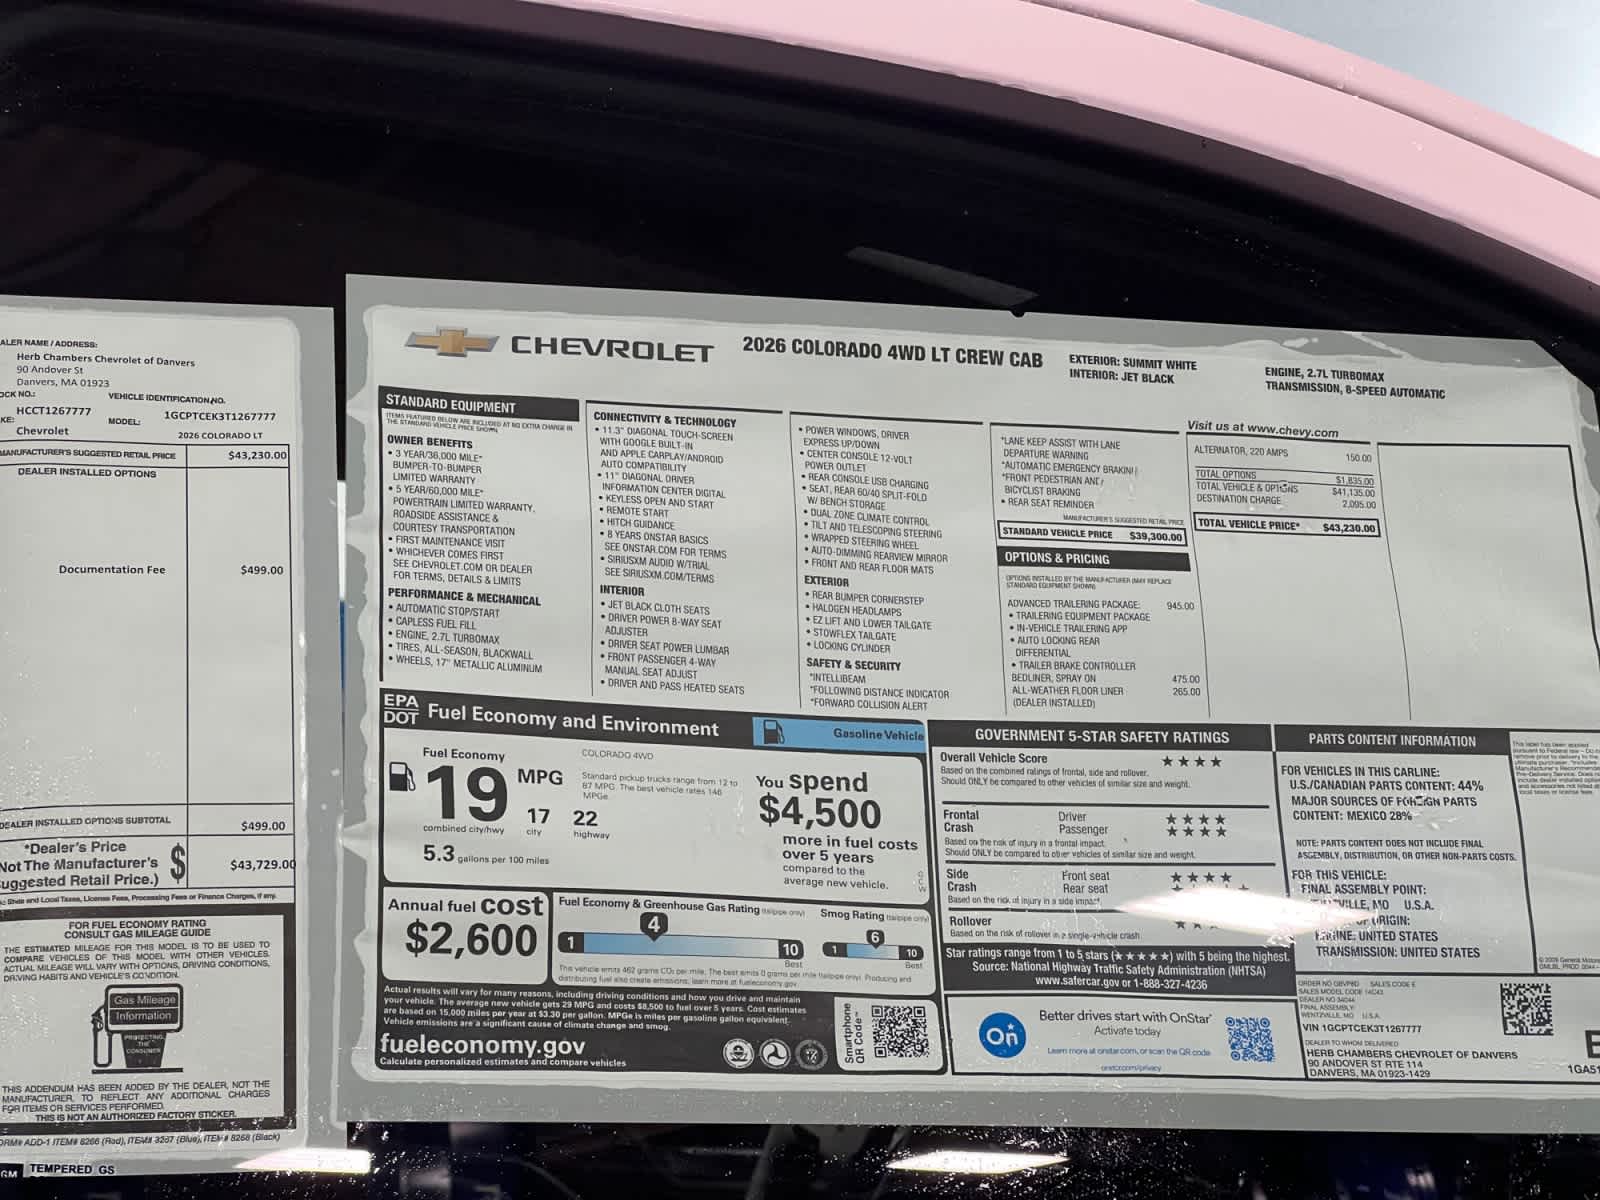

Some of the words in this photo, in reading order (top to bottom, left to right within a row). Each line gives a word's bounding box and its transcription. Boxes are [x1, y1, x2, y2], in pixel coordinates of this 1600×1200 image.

[512, 336, 715, 363] CHEVROLET
[743, 336, 786, 353] 2026
[17, 352, 40, 361] Herb
[43, 353, 93, 362] Chambers
[94, 355, 141, 364] Chevrolet
[144, 356, 154, 365] of
[156, 357, 195, 367] Danvers
[792, 338, 882, 359] COLORADO
[887, 345, 926, 361] 4WD
[931, 346, 951, 363] LT
[956, 348, 1004, 366] CREW
[1009, 351, 1043, 368] CAB
[1069, 354, 1120, 366] EXTERIOR:
[1123, 357, 1163, 369] SUMMIT
[1165, 360, 1197, 371] WHITE
[16, 365, 29, 374] 90
[30, 365, 72, 374] Andover
[74, 366, 83, 375] St
[1069, 368, 1118, 381] INTERIOR:
[1121, 372, 1139, 382] JET
[1141, 373, 1175, 384] BLACK
[1265, 367, 1304, 379] ENGINE,
[1307, 368, 1329, 379] 2.7L
[1330, 369, 1384, 382] TURBOMAX
[16, 378, 58, 387] Danvers,
[61, 378, 78, 386] MA
[80, 379, 110, 388] 01923
[1265, 381, 1343, 395] TRANSMISSION,
[1345, 385, 1387, 396] 8-SPEED
[1390, 387, 1446, 399] AUTOMATIC
[385, 393, 448, 411] STANDARD
[451, 400, 516, 414] EQUIPMENT
[108, 417, 141, 426] MODEL:
[594, 411, 661, 424] CONNECTIVITY
[664, 415, 672, 424] &
[674, 416, 737, 428] TECHNOLOGY
[16, 426, 69, 436] Chevrolet
[178, 431, 200, 439] 2026
[1188, 420, 1212, 431] Visit
[1216, 423, 1229, 431] us
[1232, 423, 1244, 432] at
[1246, 425, 1339, 440] www.chevy.com
[387, 434, 423, 445] OWNER
[426, 437, 473, 449] BENEFITS
[228, 450, 287, 461] $43,230.00
[1346, 453, 1372, 463] 150.00
[18, 467, 57, 476] DEALER
[59, 468, 112, 477] INSTALLED
[114, 469, 157, 478] OPTIONS
[606, 505, 641, 516] REMOTE
[642, 508, 669, 518] START
[607, 517, 632, 528] HITCH
[633, 519, 676, 531] GUIDANCE
[1196, 518, 1227, 530] TOTAL
[1228, 520, 1268, 532] VEHICLE
[1323, 523, 1376, 533] $43,230.00
[1001, 527, 1049, 539] STANDARD
[1050, 529, 1086, 538] VEHICLE
[1088, 530, 1113, 539] PRICE
[1129, 531, 1183, 542] $39,300.00
[1005, 551, 1050, 563] OPTIONS
[1055, 553, 1063, 563] &
[1066, 553, 1110, 565] PRICING
[59, 565, 144, 574] Documentation
[147, 565, 166, 574] Fee
[241, 565, 284, 575] $499.00
[804, 575, 849, 587] EXTERIOR
[388, 587, 464, 601] PERFORMANCE
[466, 592, 474, 602] &
[477, 593, 541, 606] MECHANICAL
[600, 584, 645, 597] INTERIOR
[1166, 601, 1195, 611] 945.00
[1172, 674, 1200, 684] 475.00
[1172, 687, 1201, 696] 265.00
[384, 693, 419, 710] EPA
[384, 711, 419, 725] DOT
[428, 703, 466, 720] Fuel
[472, 706, 557, 730] Economy
[562, 714, 596, 729] and
[602, 715, 719, 736] Environment
[833, 728, 883, 740] Gasoline
[884, 729, 925, 741] Vehicle
[975, 728, 1065, 742] GOVERNMENT
[1068, 730, 1116, 742] 5-STAR
[1120, 730, 1169, 743] SAFETY
[1173, 731, 1230, 743] RATINGS
[1309, 733, 1345, 745] PARTS
[1348, 733, 1398, 745] CONTENT
[1400, 735, 1476, 747] INFORMATION
[423, 747, 448, 758] Fuel
[451, 748, 505, 763] Economy
[518, 768, 563, 785] MPG
[756, 775, 784, 788] You
[789, 771, 868, 800] spend
[427, 765, 507, 822] 19
[528, 808, 550, 824] 17
[759, 793, 881, 830] $4,500
[943, 809, 979, 820] Frontal
[1058, 811, 1087, 822] Driver
[573, 810, 598, 827] 22
[241, 821, 286, 832] $499.00
[526, 827, 542, 837] city
[944, 822, 974, 833] Crash
[1059, 824, 1109, 837] Passenger
[573, 830, 610, 840] highway
[91, 841, 127, 853] Price
[424, 844, 455, 862] 5.3
[170, 842, 186, 884] $
[230, 856, 297, 873] $43,729.00
[388, 898, 443, 912] Annual
[447, 900, 476, 913] fuel
[481, 896, 544, 916] cost
[69, 921, 90, 930] FOR
[91, 921, 117, 929] FUEL
[119, 920, 169, 929] ECONOMY
[171, 919, 207, 928] RATING
[648, 916, 660, 933] 4
[405, 919, 537, 959] $2,600
[567, 936, 574, 949] 1
[871, 931, 880, 943] 6
[783, 943, 799, 956] 10
[1035, 975, 1120, 989] www.safercar.gov
[1121, 979, 1131, 988] or
[1133, 978, 1208, 990] 1-888-327-4236
[114, 995, 135, 1005] Gas
[137, 995, 176, 1006] Mileage
[116, 1011, 172, 1021] Information
[1094, 1025, 1134, 1036] Activate
[1135, 1026, 1162, 1038] today
[1302, 1023, 1319, 1032] VIN
[380, 1033, 585, 1061] fueleconomy.gov
[1306, 1048, 1334, 1057] HERB
[1336, 1049, 1393, 1059] CHAMBERS
[1394, 1050, 1453, 1059] CHEVROLET
[1456, 1050, 1469, 1059] OF
[1472, 1051, 1518, 1059] DANVERS
[1308, 1068, 1360, 1079] DANVERS,
[1360, 1069, 1376, 1077] MA
[1377, 1069, 1431, 1078] 01923-1429
[29, 1163, 92, 1174] TEMPERED
[98, 1165, 115, 1175] GS
